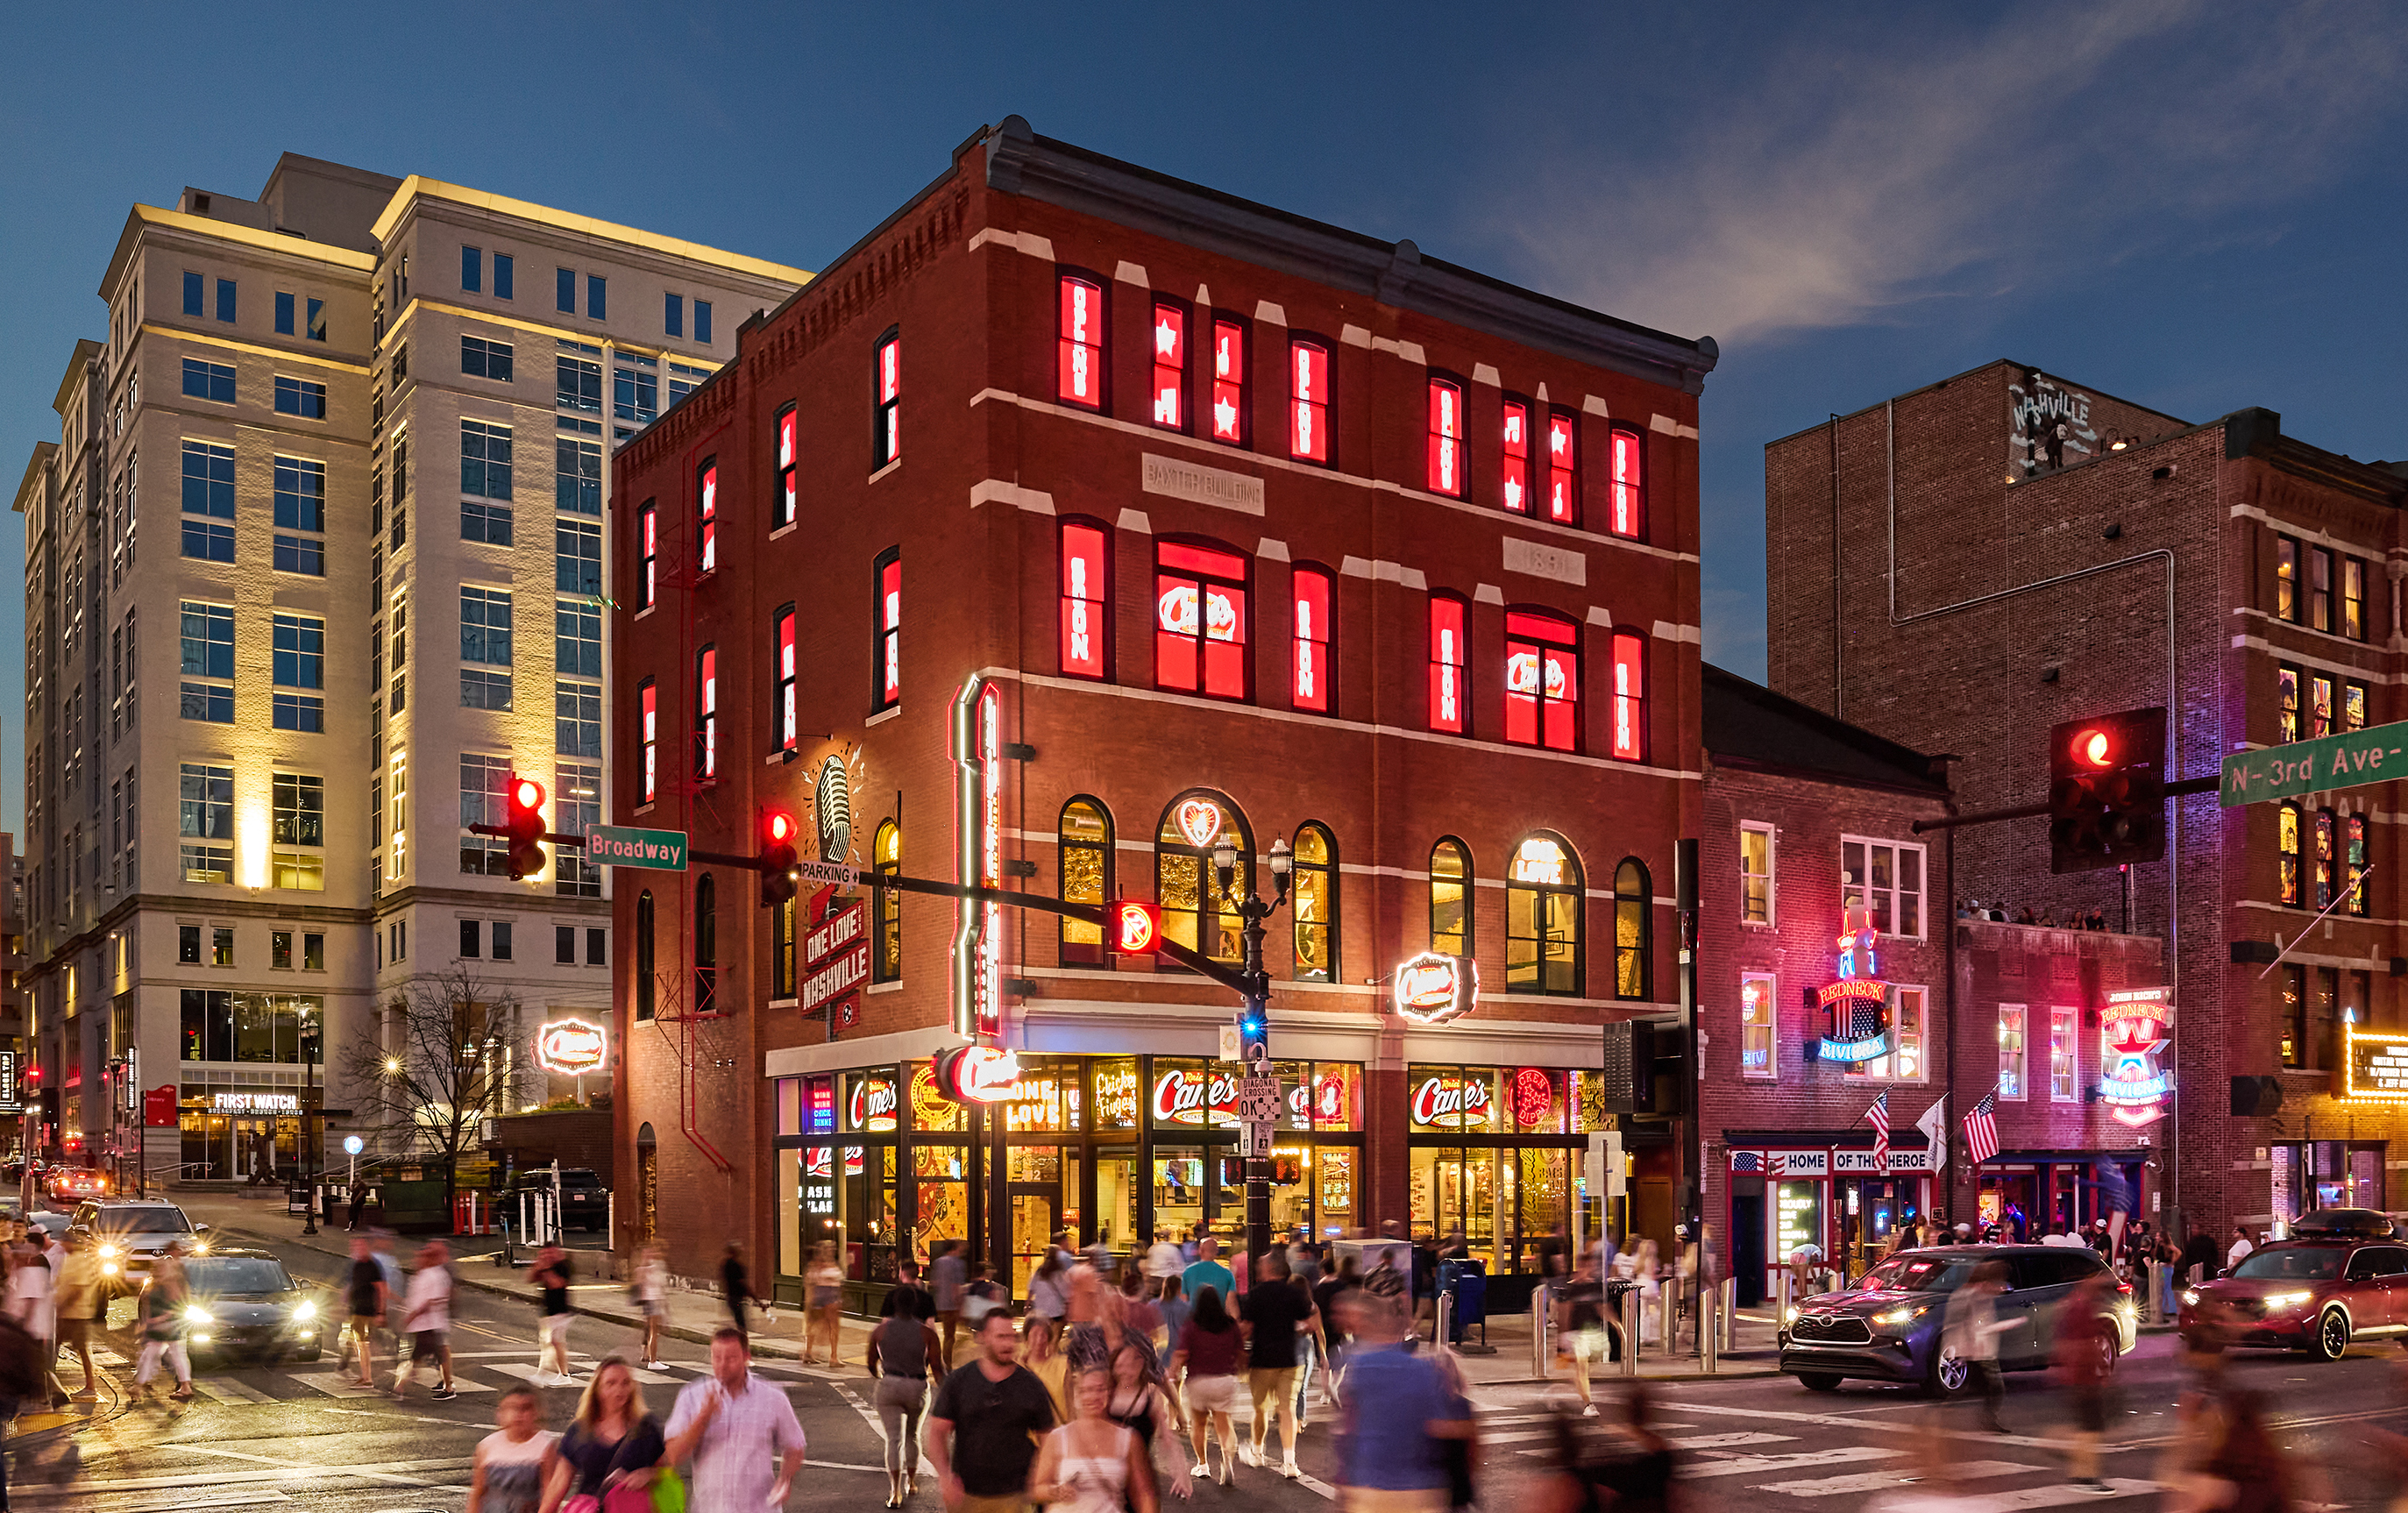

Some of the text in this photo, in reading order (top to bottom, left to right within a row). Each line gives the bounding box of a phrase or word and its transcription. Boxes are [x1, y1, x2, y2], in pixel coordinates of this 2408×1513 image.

[2014, 391, 2089, 430] NASHVILLE
[1148, 465, 1199, 493] BAXTER
[592, 834, 680, 865] Broadway
[802, 863, 849, 883] PARKING
[807, 930, 828, 963] ONE
[830, 908, 857, 948] LOVE
[803, 947, 867, 1011] NASHVILLE
[1821, 982, 1884, 1004] REDNECK
[2110, 991, 2132, 1002] JOHN
[2102, 1005, 2164, 1023] REDNECK
[1821, 1042, 1884, 1059] RIVIERA
[1184, 1072, 1216, 1084] Raisg
[1244, 1079, 1276, 1088] DIAGONAL
[1442, 1079, 1468, 1089] Raisig
[1012, 1081, 1053, 1099] ONE
[1244, 1088, 1276, 1097] CROSSING
[2104, 1080, 2163, 1096] RIVIERA
[216, 1094, 296, 1110] FIRST WATCH
[1241, 1100, 1257, 1116] OK
[1414, 1077, 1489, 1124] Cane's
[1007, 1105, 1059, 1125] LOVE
[1789, 1154, 1824, 1168] HOME
[1837, 1154, 1852, 1167] OF
[1888, 1154, 1927, 1168] HEROE
